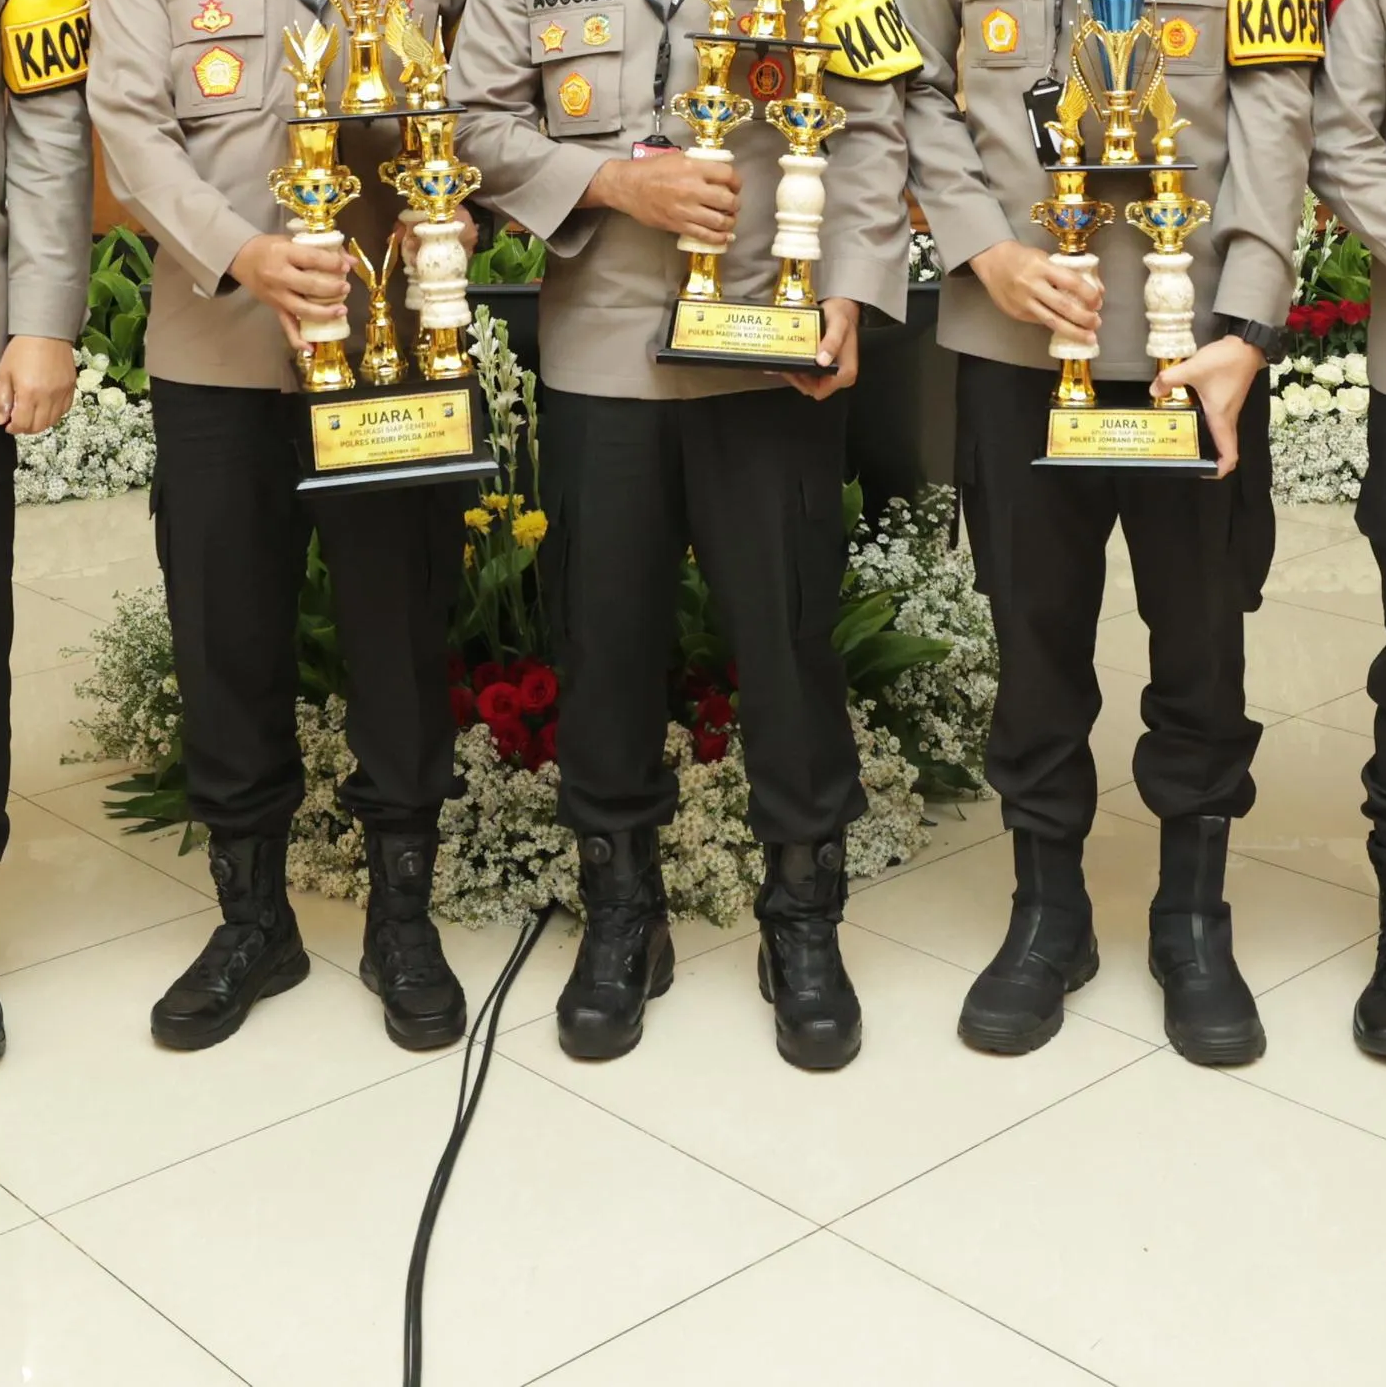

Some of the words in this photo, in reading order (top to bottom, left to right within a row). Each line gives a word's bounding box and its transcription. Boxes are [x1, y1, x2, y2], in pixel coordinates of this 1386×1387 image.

[15, 16, 91, 81] KAOP
[725, 313, 763, 326] JUARA
[765, 316, 772, 326] 2
[688, 328, 715, 337] POLRES
[744, 332, 762, 340] KOTA
[763, 333, 785, 342] POLDA
[786, 335, 806, 343] JATIM
[358, 408, 413, 427] JUARA
[417, 406, 425, 420] 1
[1099, 419, 1138, 429] JUARA
[1141, 419, 1148, 429] 3
[340, 438, 370, 448] POLRES
[371, 435, 396, 445] KEDIRI
[397, 432, 422, 442] POLDA
[424, 430, 446, 440] JATIM
[1069, 436, 1096, 444] POLRES
